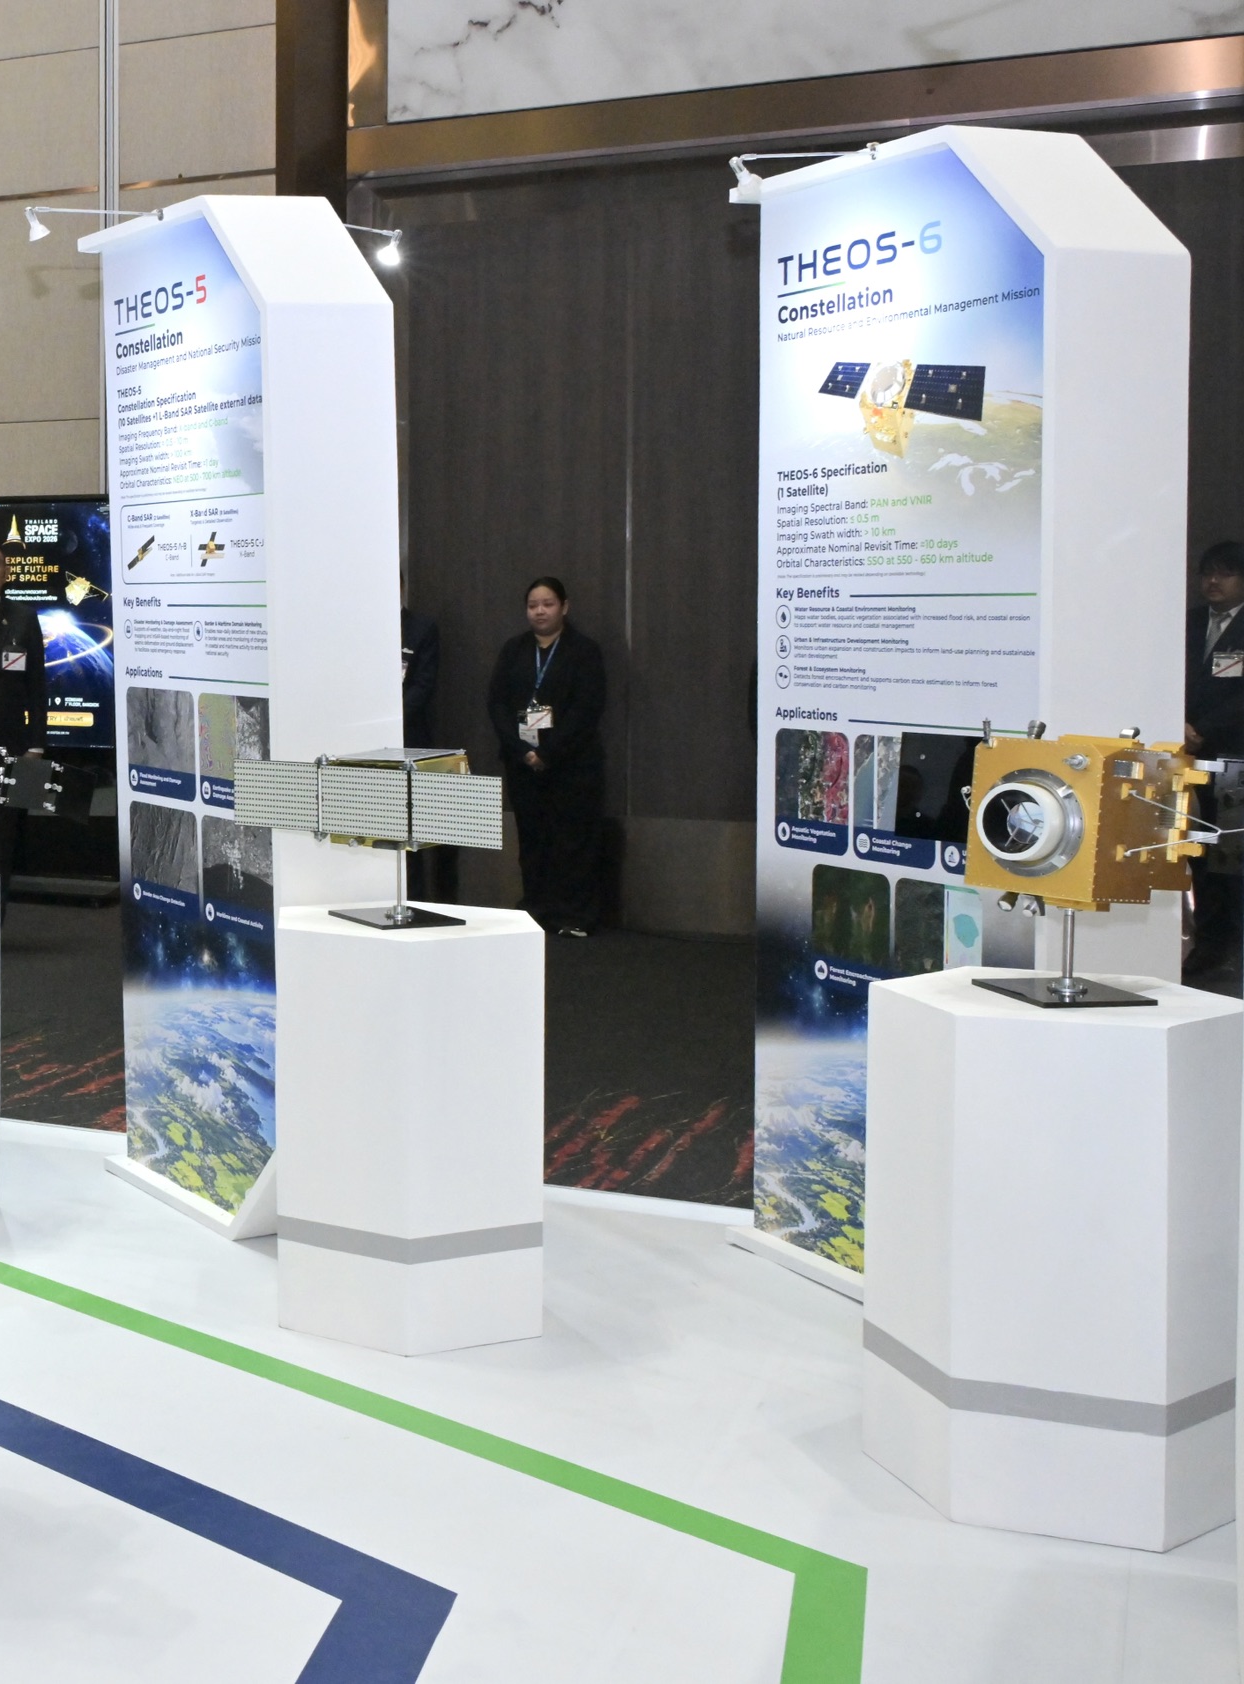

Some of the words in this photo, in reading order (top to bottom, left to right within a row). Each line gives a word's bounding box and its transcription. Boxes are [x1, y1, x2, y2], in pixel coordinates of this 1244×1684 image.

[777, 220, 942, 286] THEOS-6
[114, 274, 206, 325] THEOS-5
[778, 286, 893, 324] Constellation
[777, 328, 806, 343] Natural
[808, 322, 845, 338] Resource
[866, 305, 931, 327] Environmental
[935, 293, 998, 316] Management
[1001, 285, 1040, 303] Mission
[116, 329, 183, 359] Constellation
[116, 363, 137, 375] Disaster
[139, 355, 175, 370] Management
[176, 351, 187, 363] and
[188, 344, 213, 359] National
[214, 339, 239, 354] Security
[241, 334, 261, 349] Missio
[117, 386, 141, 399] THEOS-5
[118, 398, 155, 414] Constellation
[156, 391, 196, 408] Specification
[127, 413, 151, 426] Satellites
[159, 408, 179, 420] L-Band
[181, 406, 192, 417] SAR
[194, 401, 218, 414] Satellite
[220, 396, 246, 410] external
[248, 394, 262, 405] data
[119, 432, 137, 442] Imaging
[138, 428, 162, 438] Frequency
[119, 444, 134, 453] Spatial
[777, 467, 818, 482] THEOS-6
[821, 462, 888, 480] Specification
[120, 480, 135, 489] Orbital
[777, 487, 784, 500] (1
[786, 484, 828, 498] Satellite)
[208, 508, 218, 516] SAR
[777, 503, 808, 516] Imaging
[811, 501, 842, 514] Spectral
[845, 498, 868, 510] Band:
[870, 497, 889, 508] PAN
[891, 497, 907, 507] and
[909, 495, 932, 506] VNIR
[777, 517, 802, 529] Spatial
[805, 514, 848, 527] Resolution:
[857, 514, 869, 524] 0.5
[871, 515, 879, 523] m
[25, 525, 58, 535] SPACE
[777, 531, 808, 543] Imaging
[811, 529, 835, 540] Swath
[837, 528, 862, 539] width:
[871, 528, 880, 536] 10
[882, 527, 896, 536] km
[230, 539, 254, 548] THEOS-5
[777, 544, 826, 556] Approximate
[828, 542, 862, 554] Nominal
[864, 541, 892, 551] Revisit
[894, 540, 918, 551] Time:
[936, 538, 958, 550] days
[777, 558, 802, 569] Orbital
[804, 555, 865, 568] Characteristics:
[867, 555, 884, 566] SSO
[886, 555, 895, 565] at
[897, 555, 912, 565] 550
[920, 554, 936, 564] 650
[939, 553, 954, 564] km
[956, 552, 993, 563] altitude
[776, 588, 794, 601] Key
[797, 587, 839, 599] Benefits
[123, 597, 134, 609] Key
[136, 597, 161, 607] Benefits
[125, 666, 163, 679] Applications
[776, 707, 838, 722] Applications
